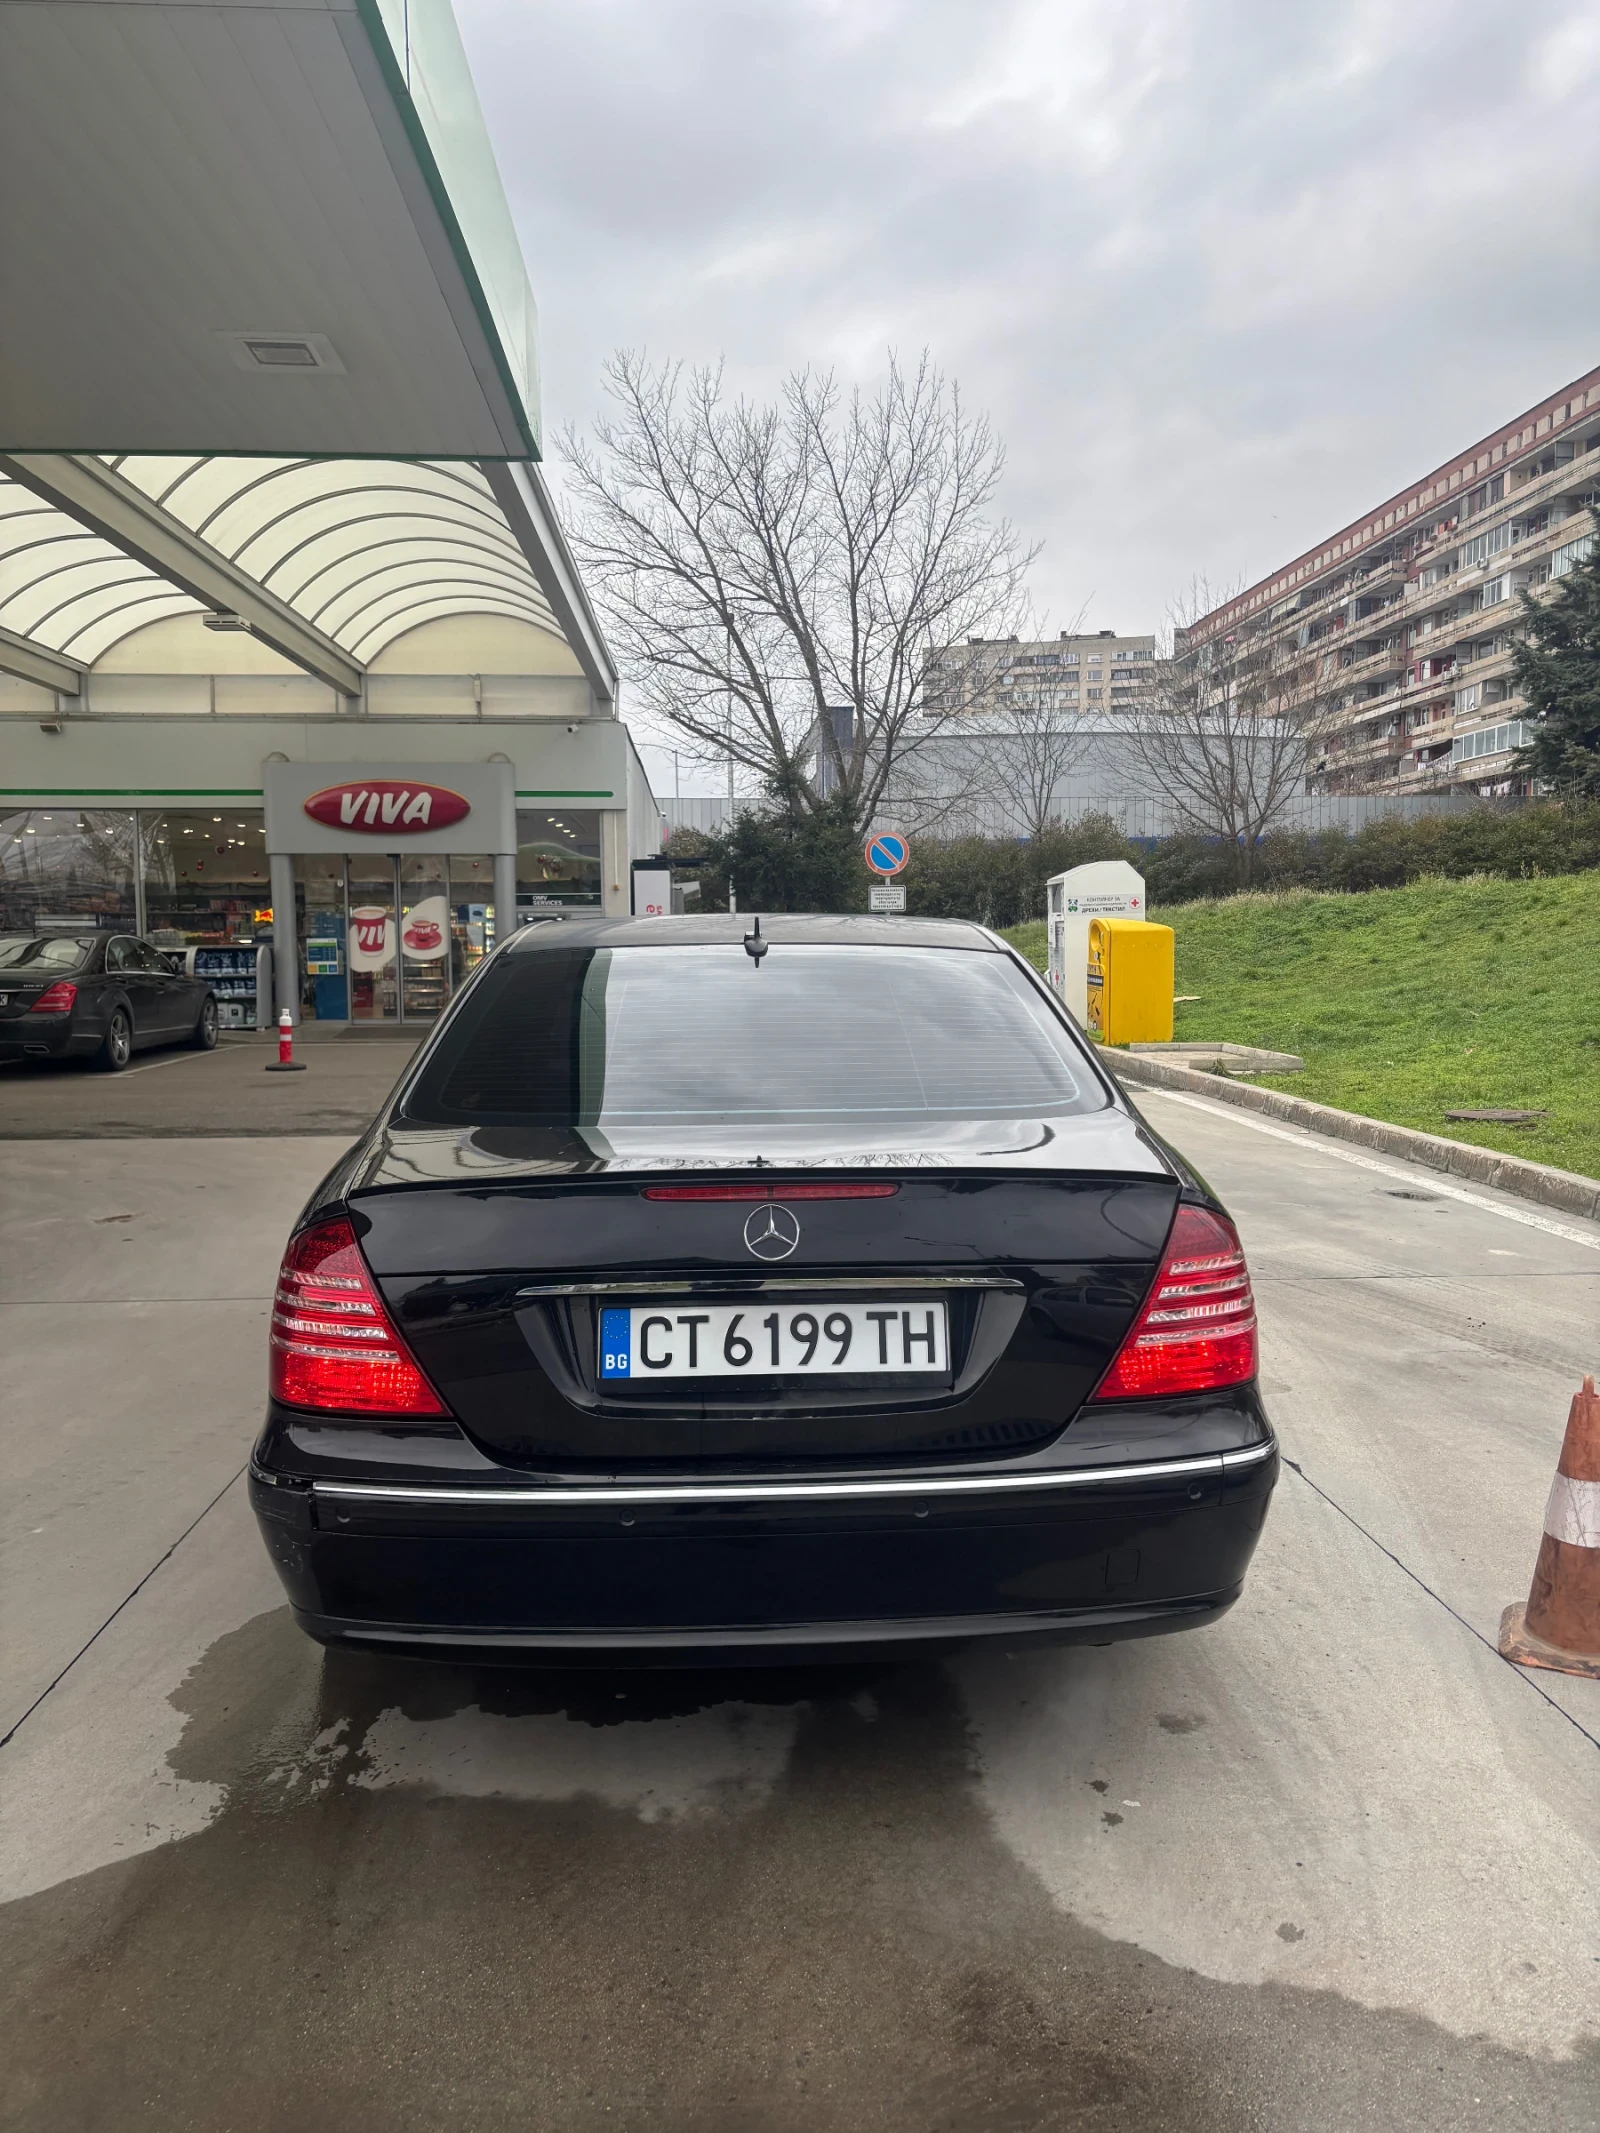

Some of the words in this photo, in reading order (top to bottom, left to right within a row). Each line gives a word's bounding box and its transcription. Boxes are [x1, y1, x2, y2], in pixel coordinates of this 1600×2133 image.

[340, 790, 433, 825] VIVA
[640, 1314, 710, 1370] CT
[723, 1312, 853, 1368] 6199
[866, 1310, 936, 1365] TH
[605, 1353, 628, 1370] BG
